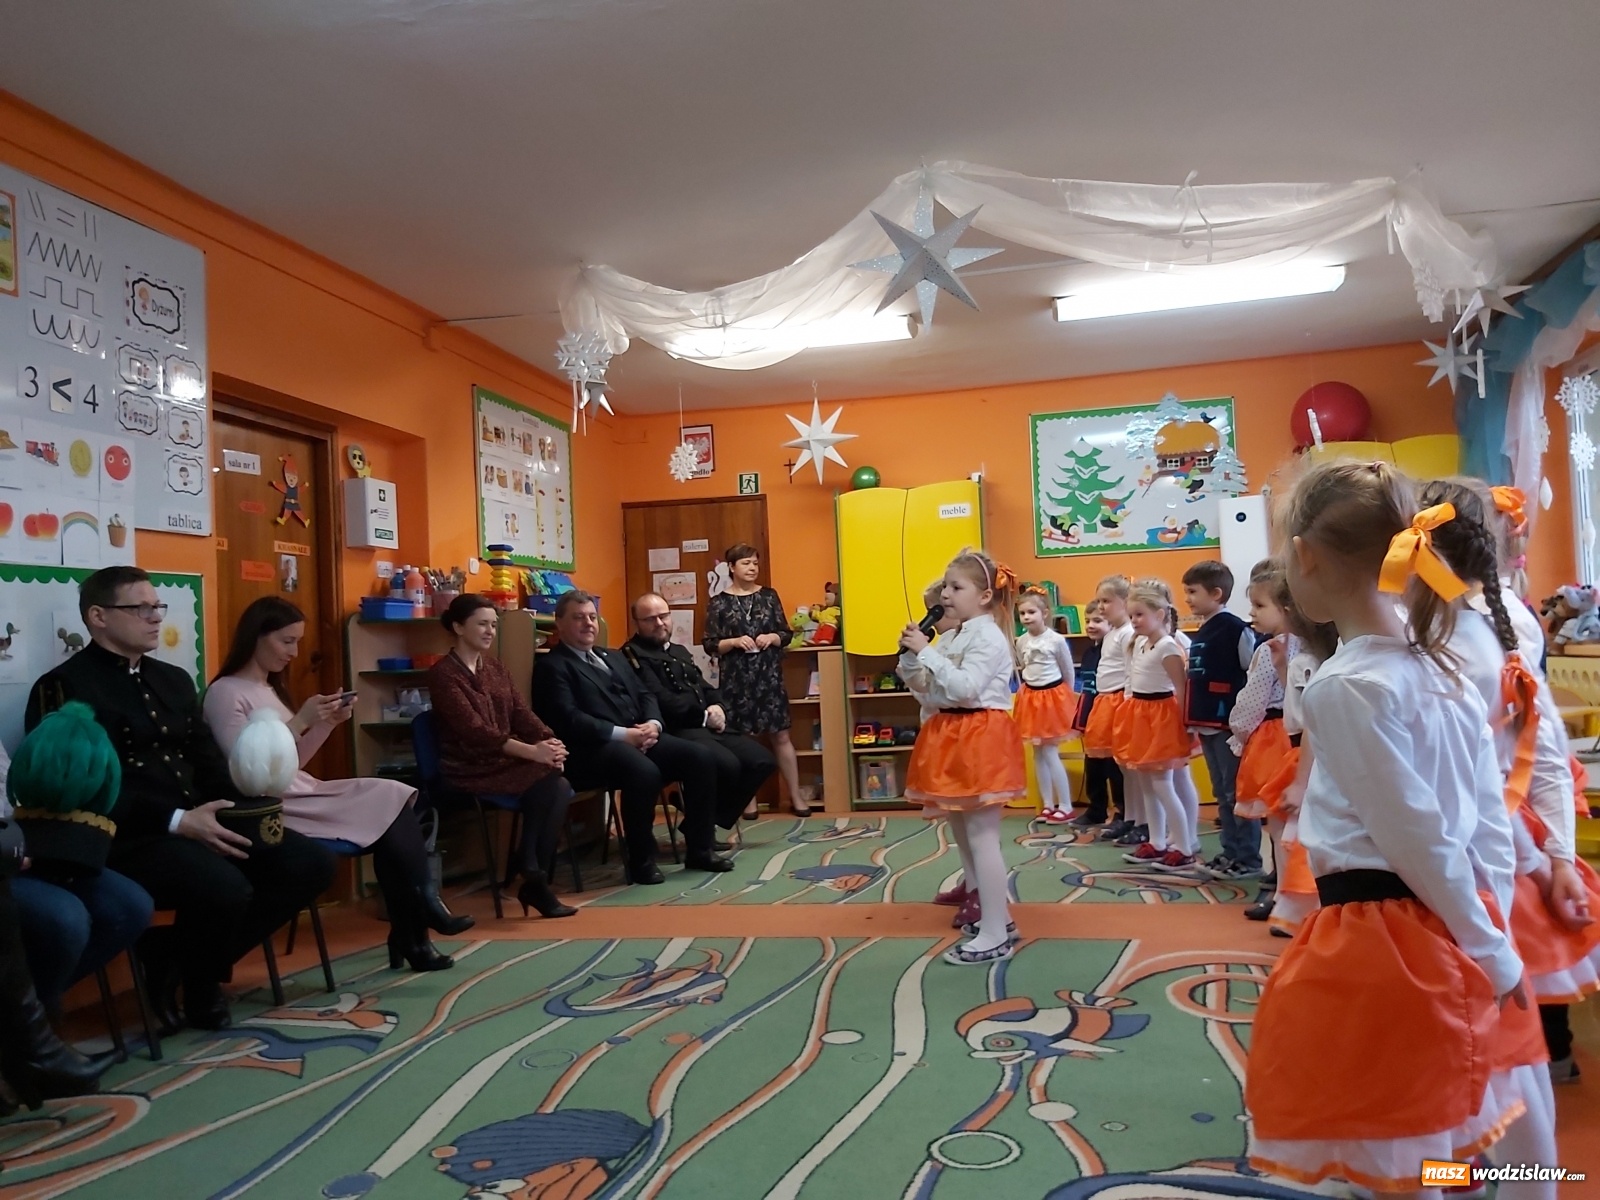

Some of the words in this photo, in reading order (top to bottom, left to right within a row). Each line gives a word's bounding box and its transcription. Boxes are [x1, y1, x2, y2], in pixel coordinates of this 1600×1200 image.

[24, 366, 39, 398] 3
[83, 384, 99, 413] 4
[228, 459, 242, 468] sala
[941, 506, 966, 515] meble
[168, 513, 203, 530] tablica
